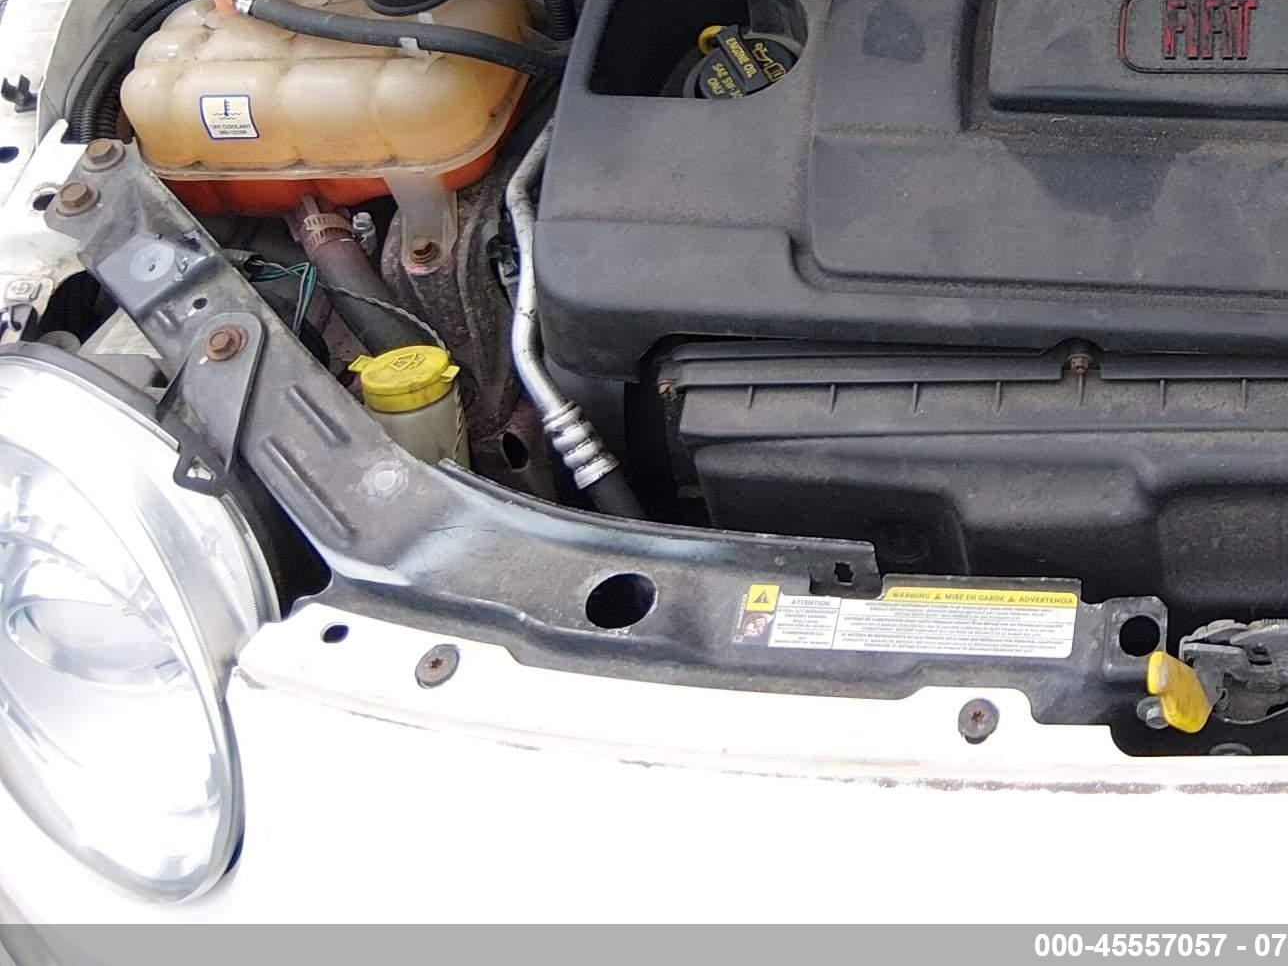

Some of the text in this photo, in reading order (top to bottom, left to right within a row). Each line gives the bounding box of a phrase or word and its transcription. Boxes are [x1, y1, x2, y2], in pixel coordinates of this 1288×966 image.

[725, 37, 758, 78] ENGINE OIL
[1018, 596, 1073, 604] ADVERTENCIA
